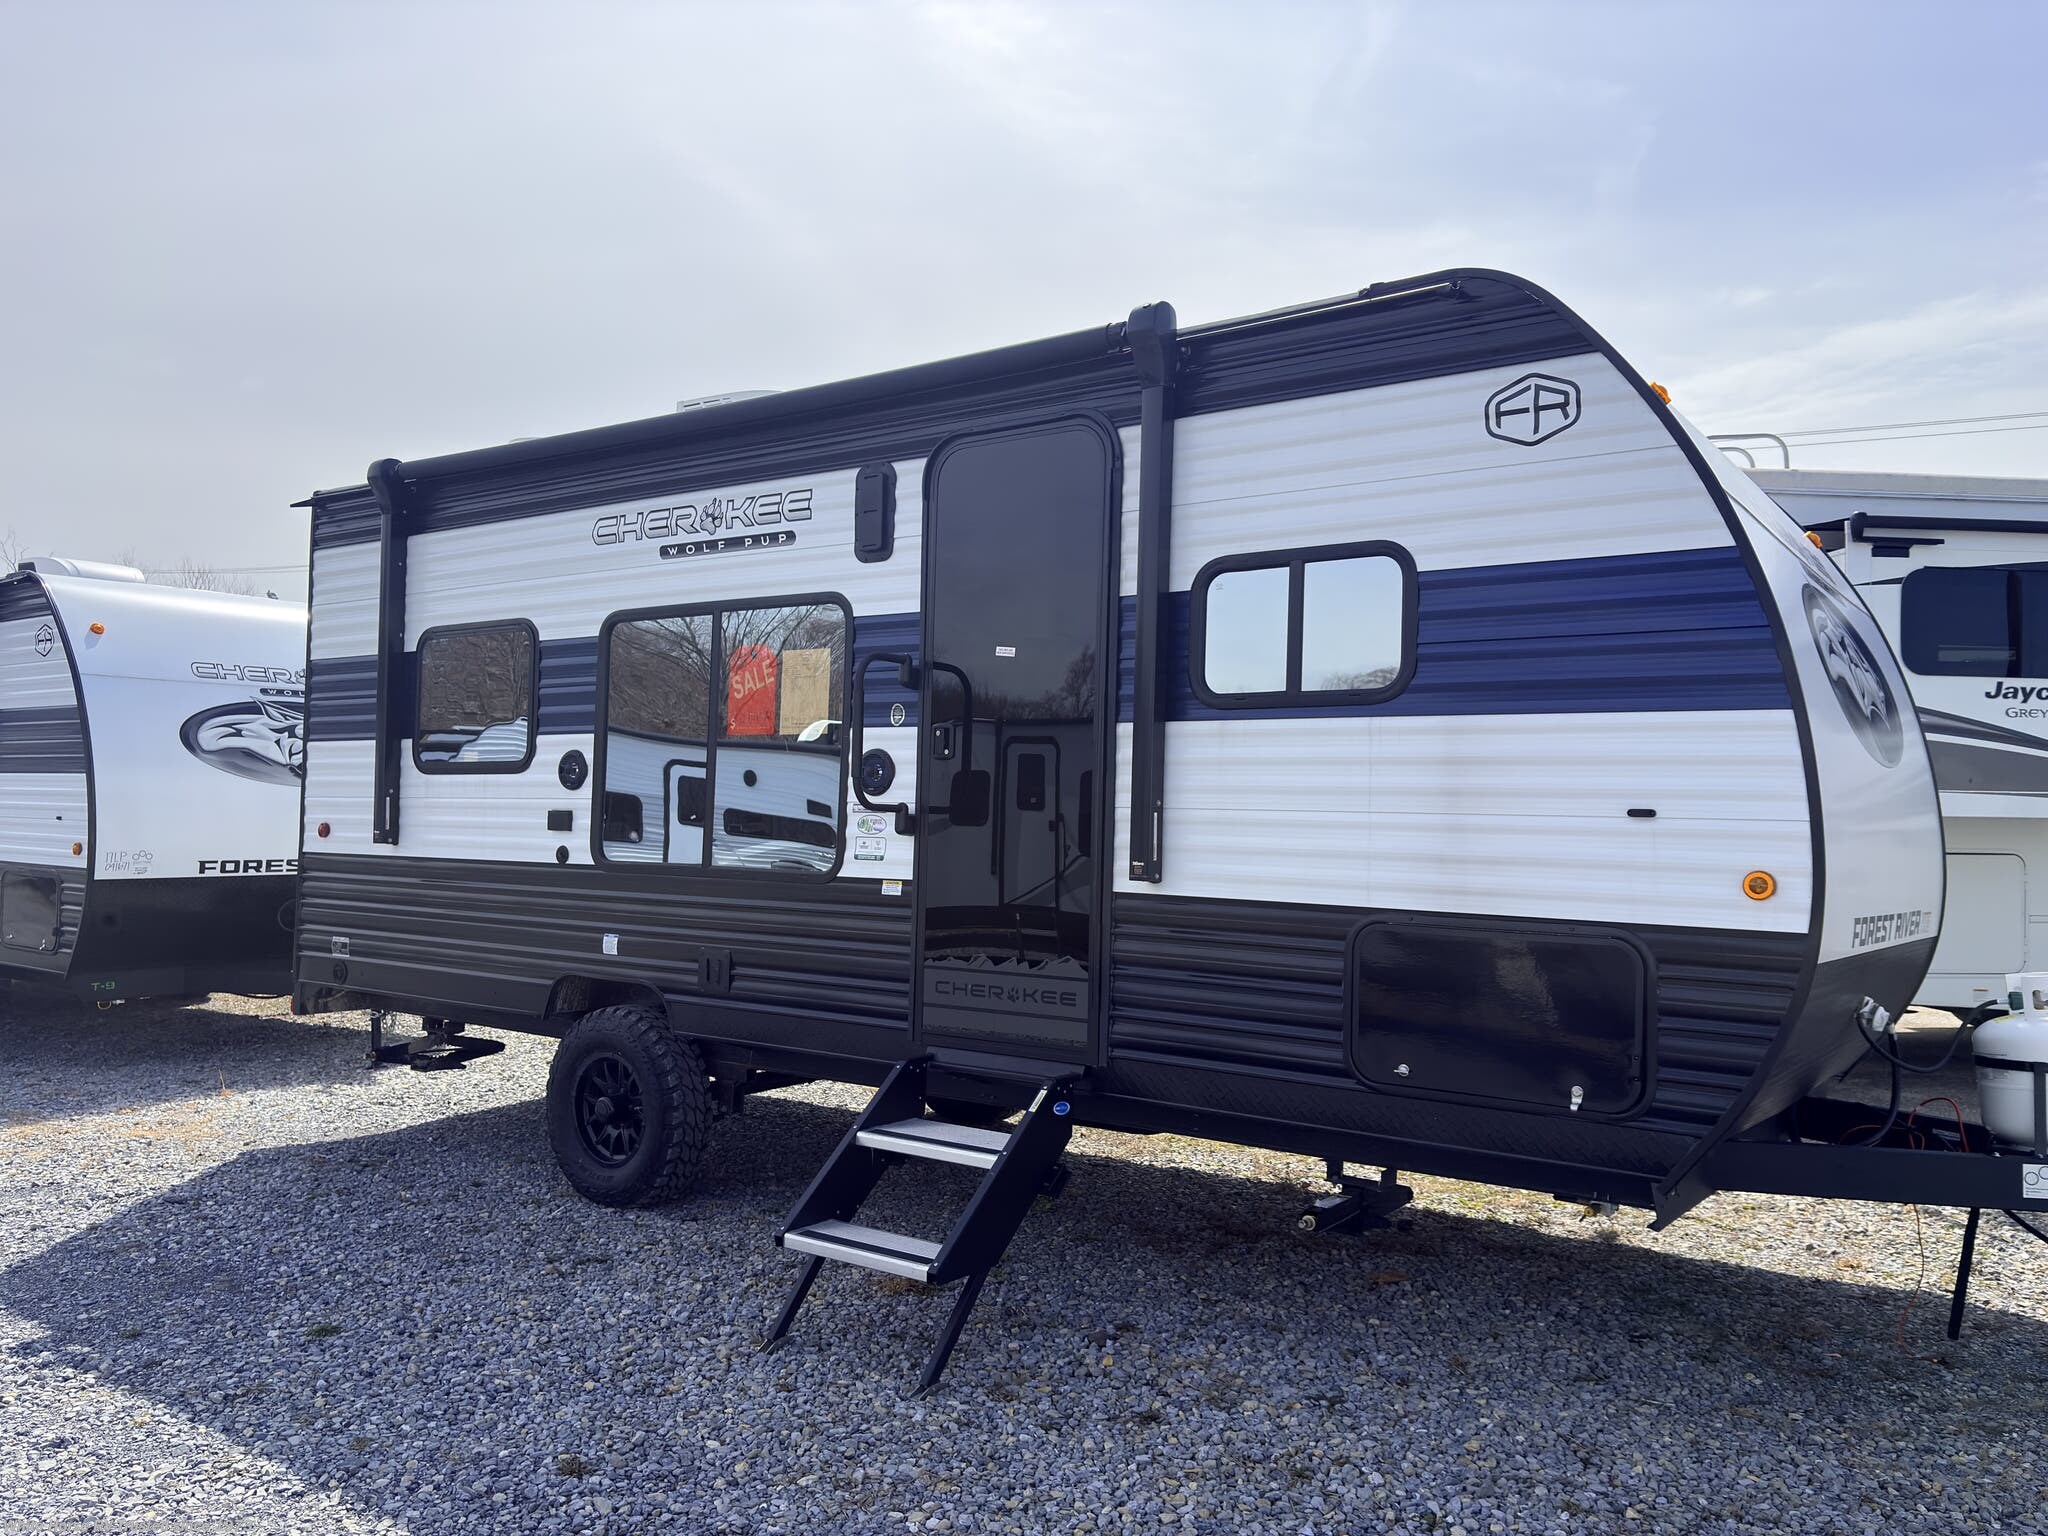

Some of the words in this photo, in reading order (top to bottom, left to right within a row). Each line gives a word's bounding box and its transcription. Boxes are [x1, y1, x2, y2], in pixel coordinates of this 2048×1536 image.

[667, 540, 726, 557] WOLF
[744, 533, 787, 549] PUP
[731, 659, 775, 700] SALE
[1984, 681, 2048, 704] Jayc
[1852, 913, 1895, 949] FOREST
[1894, 909, 1921, 940] RIVER
